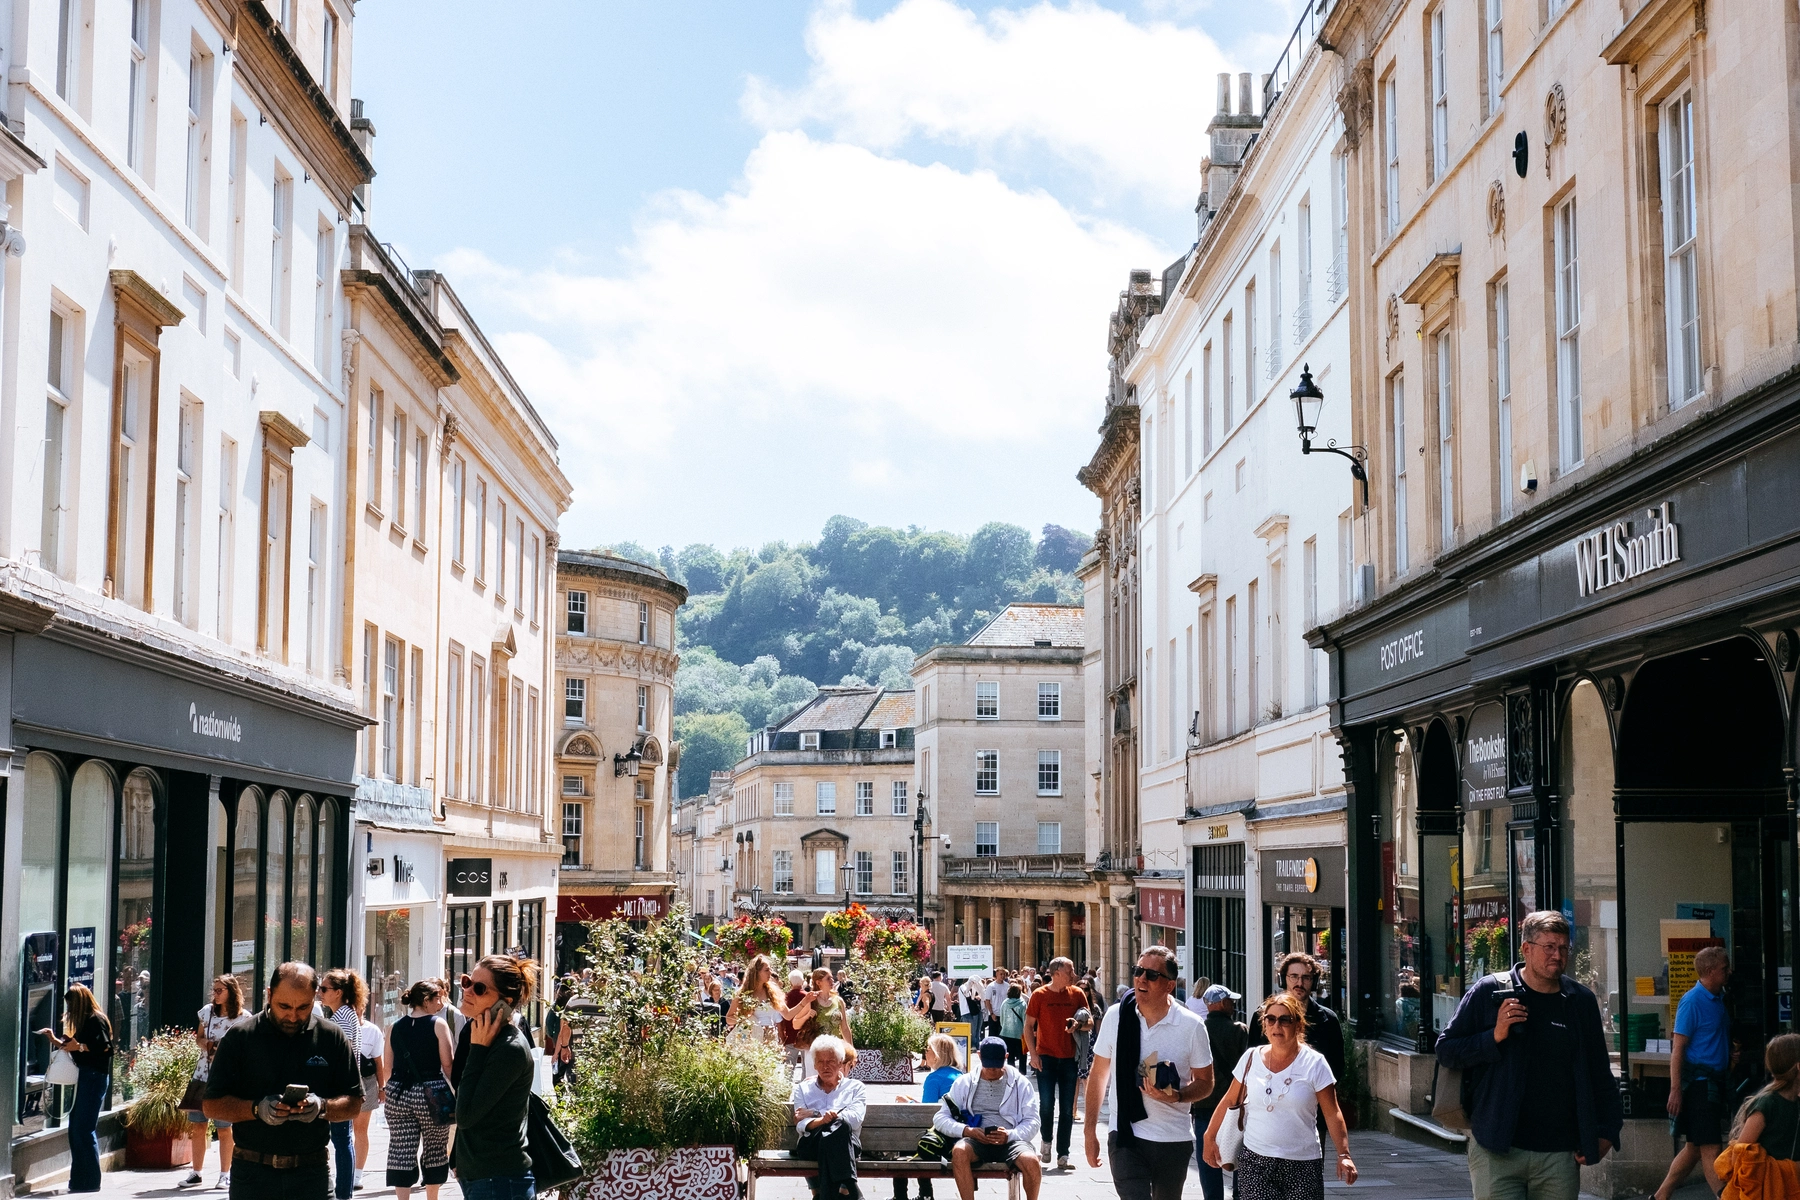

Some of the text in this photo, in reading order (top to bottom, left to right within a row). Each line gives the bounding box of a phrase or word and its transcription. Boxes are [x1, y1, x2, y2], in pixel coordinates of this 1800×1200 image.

[1575, 501, 1680, 597] WHSmith
[1380, 629, 1424, 671] POST OFFICE
[198, 710, 241, 742] nationwide
[1468, 733, 1506, 764] TheBooksho
[1468, 786, 1506, 802] ON THE FIRST FLO
[455, 871, 489, 884] COS
